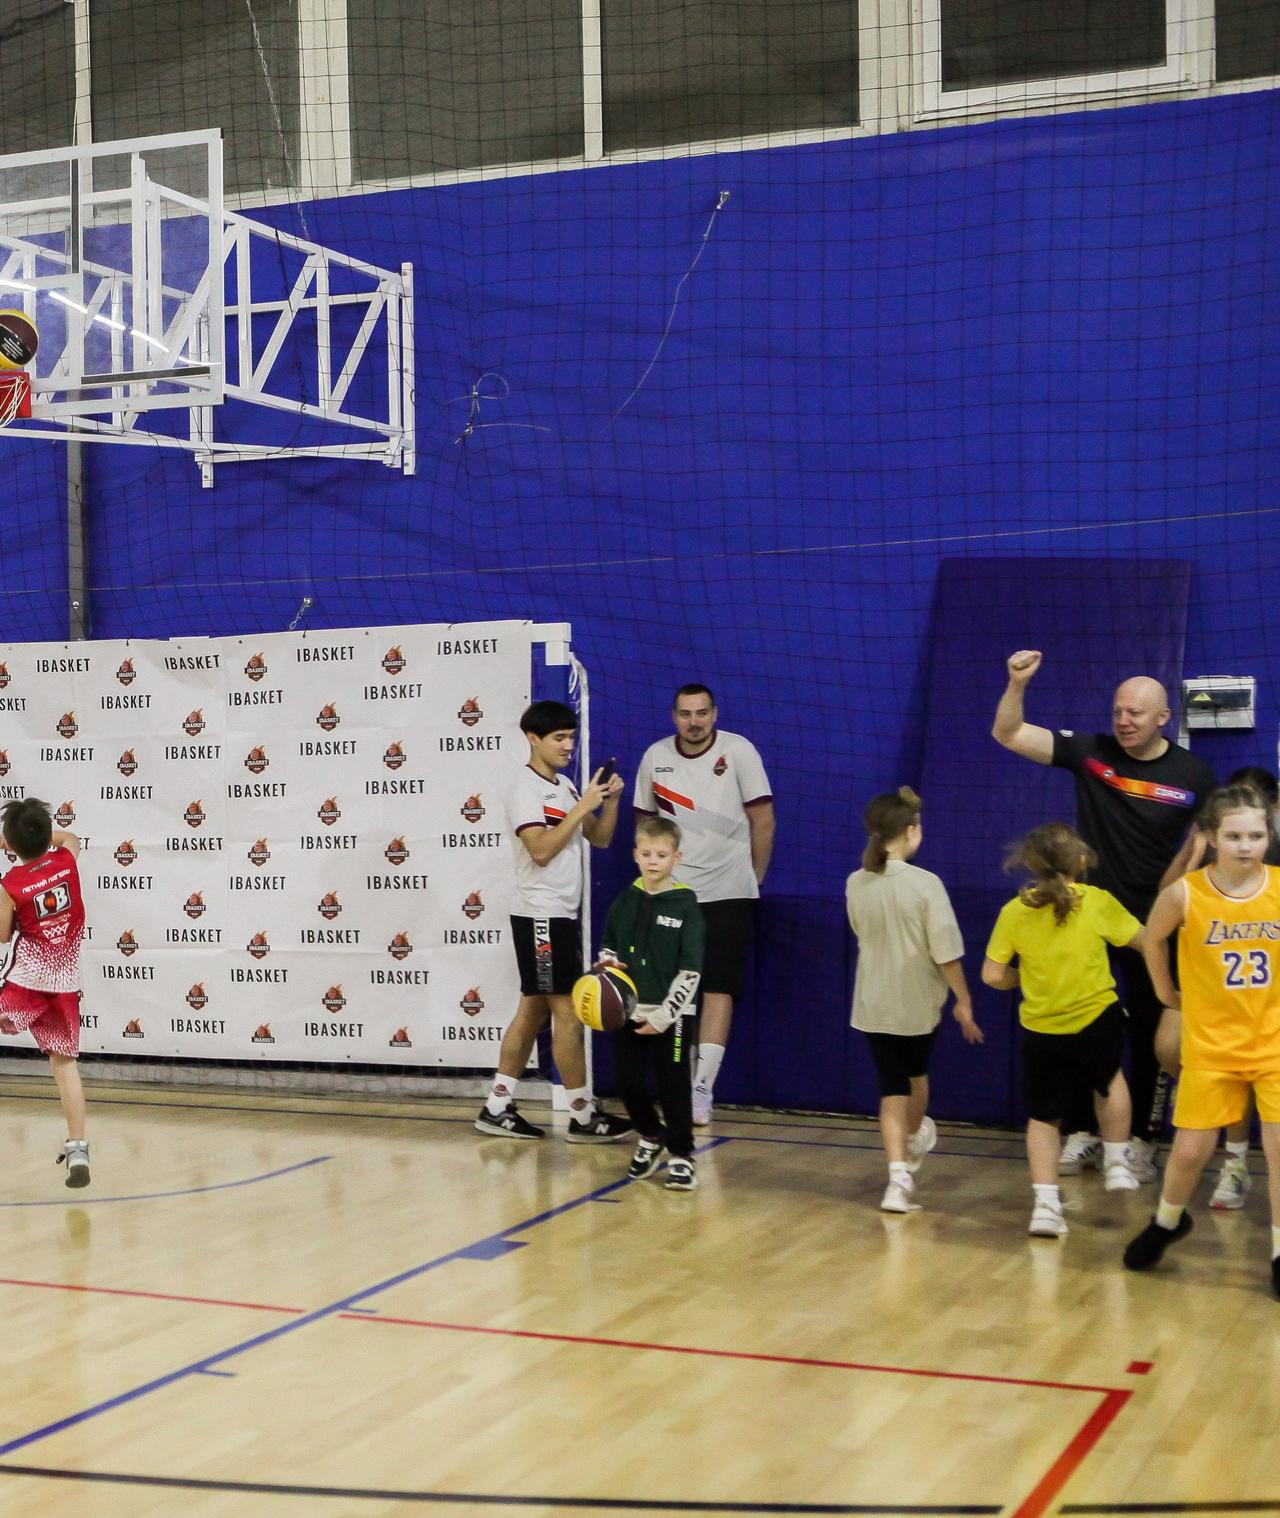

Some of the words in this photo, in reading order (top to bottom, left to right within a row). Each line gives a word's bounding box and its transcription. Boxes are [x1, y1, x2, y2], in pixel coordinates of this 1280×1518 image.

[438, 639, 497, 655] IBASKET
[297, 647, 354, 662] IBASKET
[37, 659, 90, 672] IBASKET
[165, 655, 219, 669] IBASKET
[229, 690, 282, 706] IBASKET
[364, 684, 422, 699] IBASKET
[102, 695, 151, 709] IBASKET
[301, 741, 356, 755] IBASKET
[440, 736, 501, 751] IBASKET
[41, 748, 93, 761] IBASKET
[166, 746, 220, 759] IBASKET
[101, 786, 152, 799] IBASKET
[229, 784, 286, 798] IBASKET
[366, 780, 424, 794] IBASKET
[167, 838, 222, 851] IBASKET
[301, 836, 357, 849] IBASKET
[443, 833, 500, 847] IBASKET
[98, 876, 152, 889] IBASKET
[230, 877, 285, 889] IBASKET
[367, 876, 428, 889] IBASKET
[167, 929, 221, 942] IBASKET
[301, 930, 360, 943] IBASKET
[444, 930, 501, 944] IBASKET
[103, 966, 154, 979] IBASKET
[231, 969, 287, 982] IBASKET
[1223, 950, 1271, 988] 23
[371, 971, 429, 984] IBASKET
[171, 1019, 225, 1033] IBASKET
[305, 1023, 363, 1037] IBASKET
[443, 1026, 503, 1041] IBASKET
